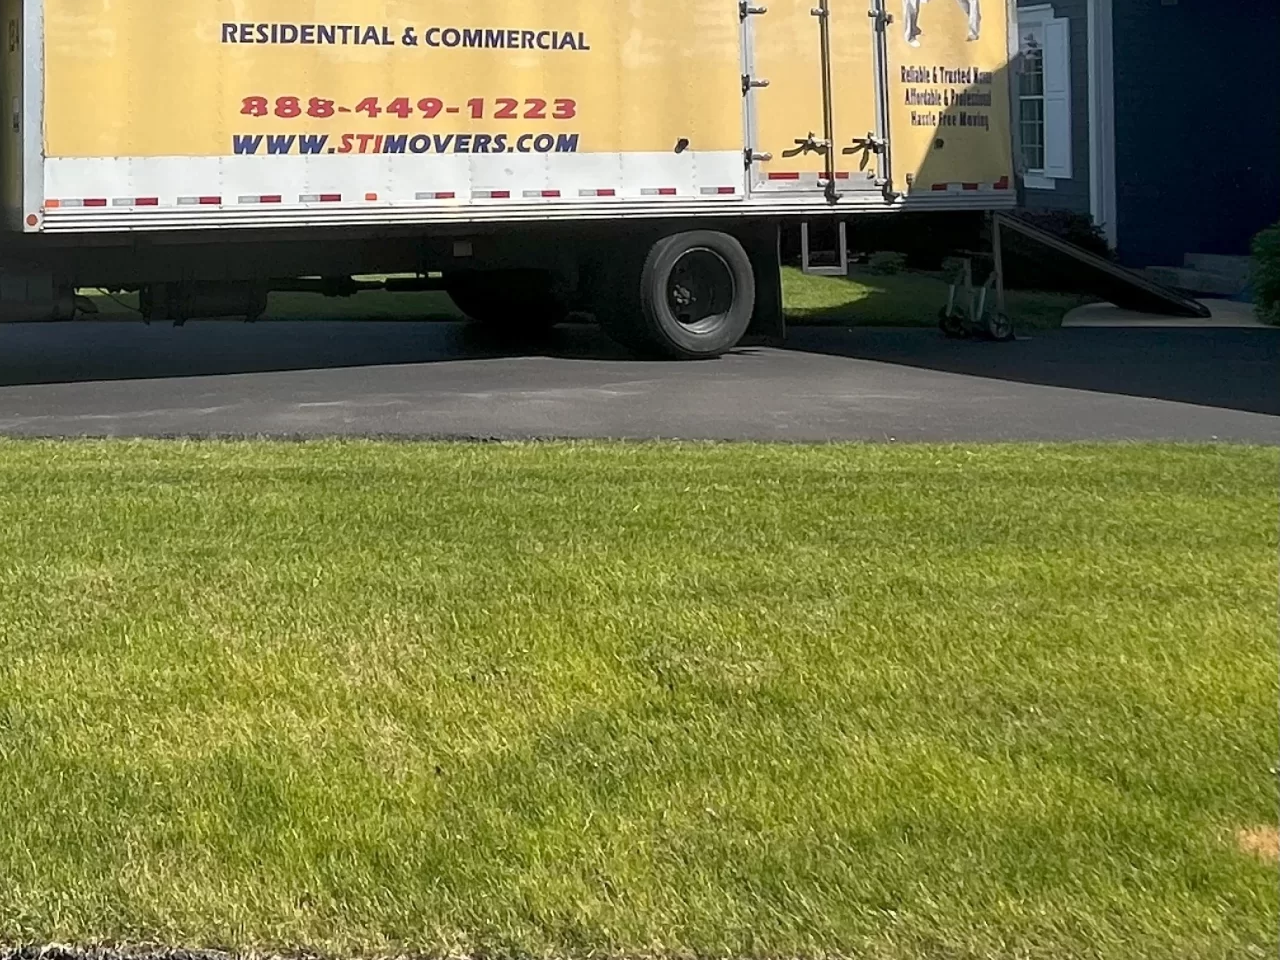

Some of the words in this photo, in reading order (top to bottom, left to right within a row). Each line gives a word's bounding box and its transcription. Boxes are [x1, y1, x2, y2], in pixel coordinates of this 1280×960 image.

[221, 23, 395, 46] RESIDENTIAL
[401, 26, 418, 46] &
[425, 27, 590, 51] COMMERCIAL
[901, 65, 930, 83] Reliable
[939, 66, 971, 84] Trusted
[240, 95, 577, 119] 888-449-1223
[904, 88, 941, 106] Affordable
[939, 111, 957, 127] Free
[959, 111, 989, 132] Moving
[232, 133, 579, 154] WWW.STIMOVERS.COM
